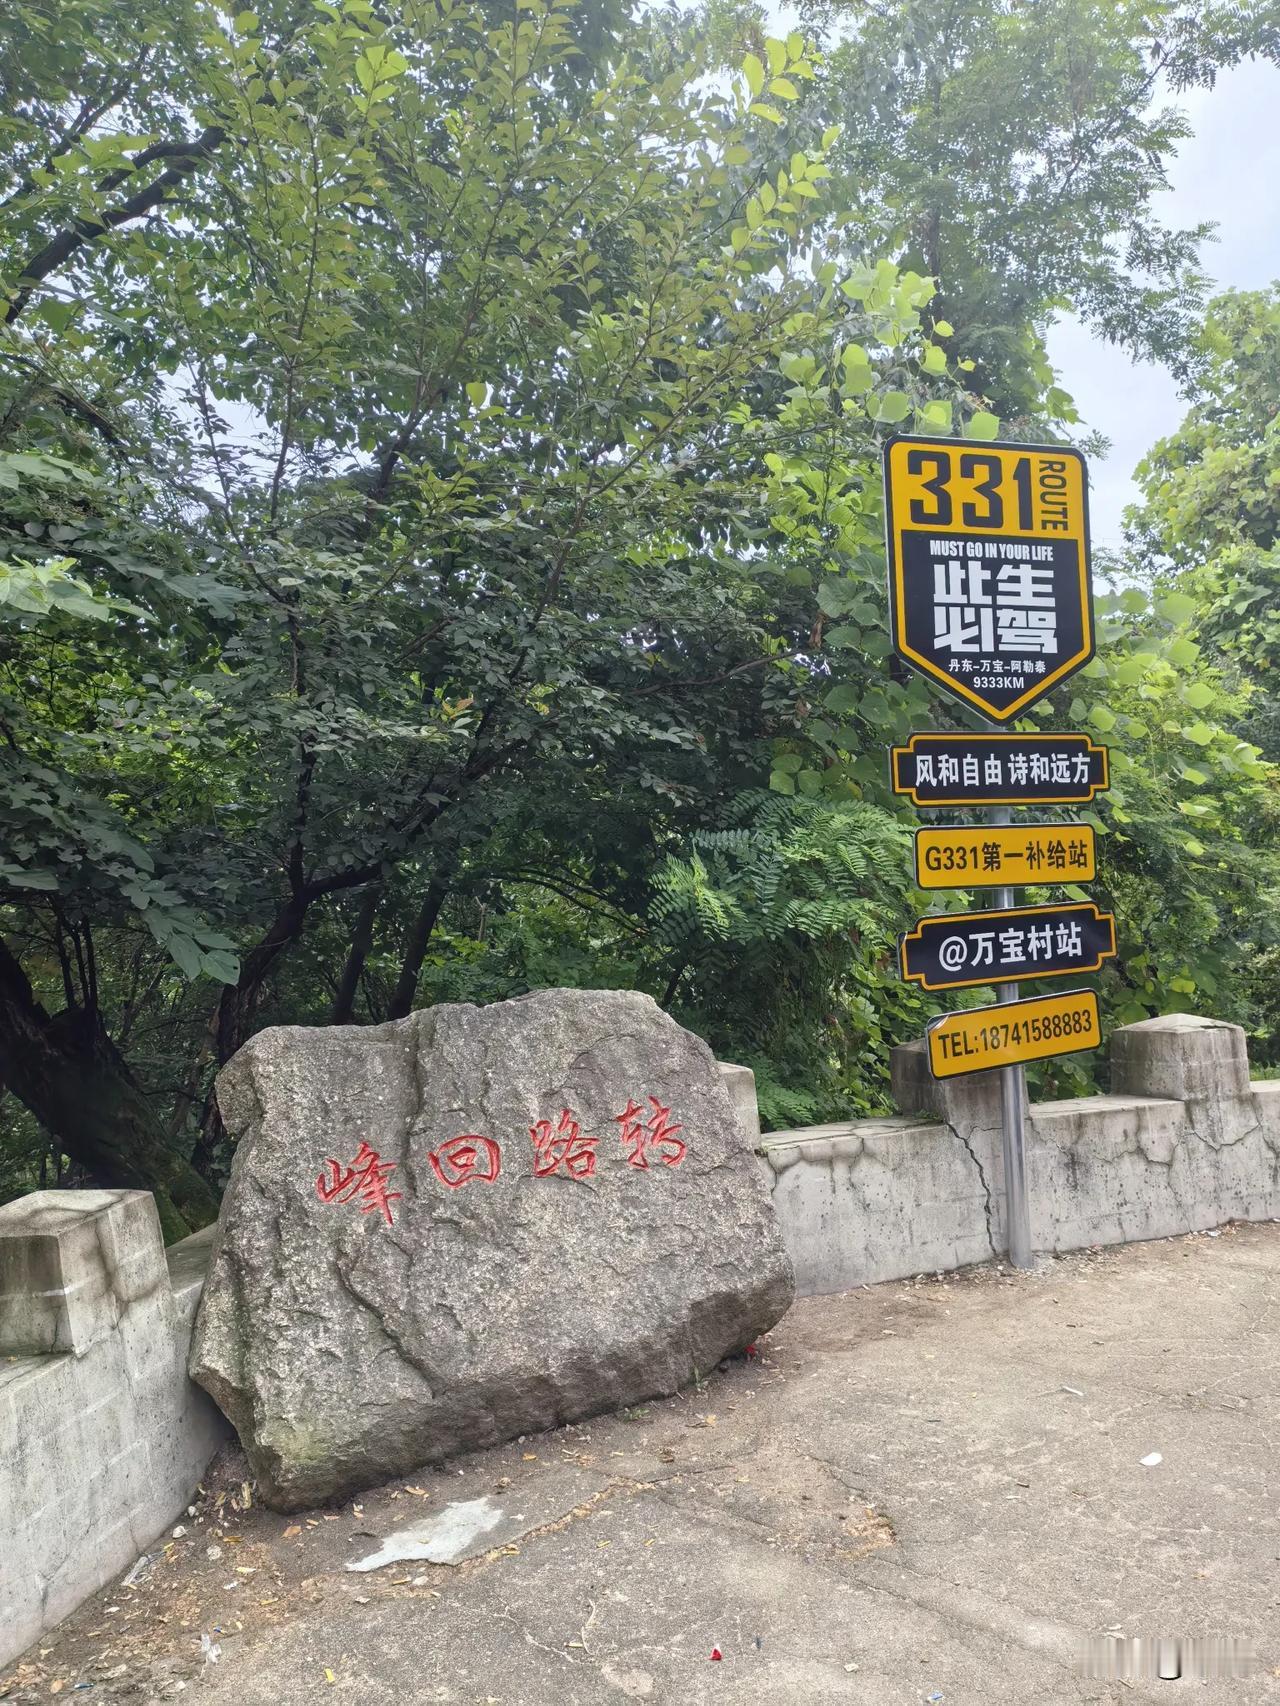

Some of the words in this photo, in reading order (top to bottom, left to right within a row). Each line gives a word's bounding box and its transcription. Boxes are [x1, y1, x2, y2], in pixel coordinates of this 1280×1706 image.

[908, 450, 1034, 531] 331
[1039, 460, 1069, 531] ROUTE
[930, 540, 965, 557] MUST
[966, 542, 983, 558] GO
[984, 543, 997, 559] IN
[998, 543, 1030, 560] YOUR
[1031, 545, 1054, 561] LIFE
[933, 560, 1056, 607] 此生
[933, 606, 1058, 654] 必驾
[973, 676, 1025, 689] 9333KM
[915, 753, 1003, 788] 风和自由
[1007, 752, 1091, 786] 诗和远方
[925, 839, 1089, 872] G331第一补给站
[938, 921, 1083, 972] @万宝村站
[938, 1009, 1093, 1060] TEL:18741588883
[315, 1096, 687, 1227] 峰回路转
